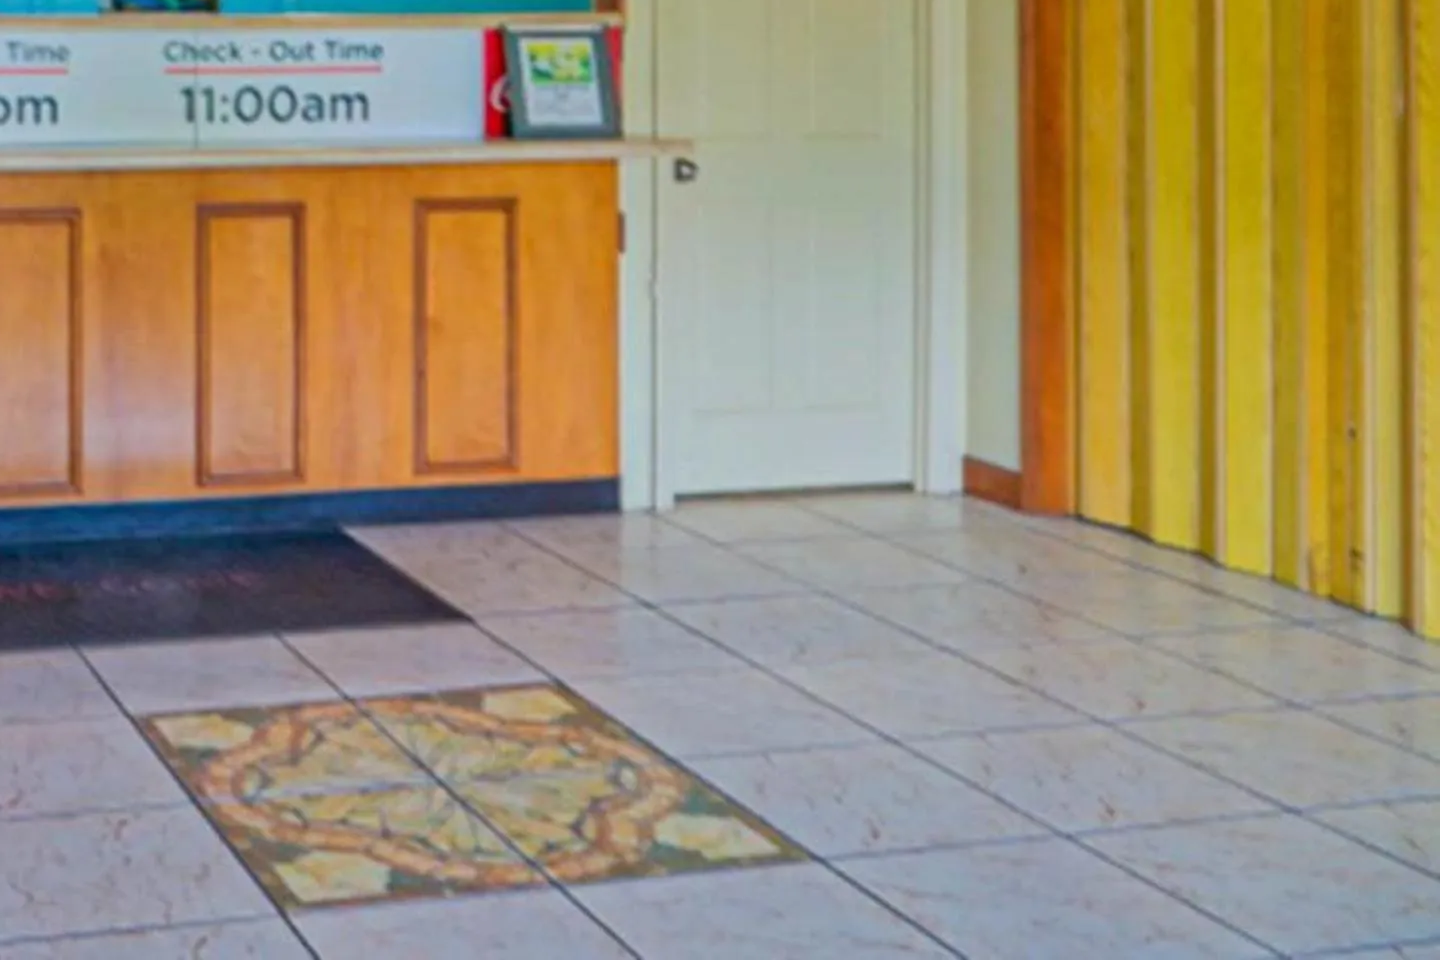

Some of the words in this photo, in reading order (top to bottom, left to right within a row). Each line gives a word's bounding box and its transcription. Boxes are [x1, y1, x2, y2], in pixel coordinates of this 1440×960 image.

[6, 41, 71, 64] Time
[164, 40, 242, 62] Check
[269, 41, 316, 61] Out
[324, 39, 383, 61] Time
[181, 86, 369, 123] 11:00am
